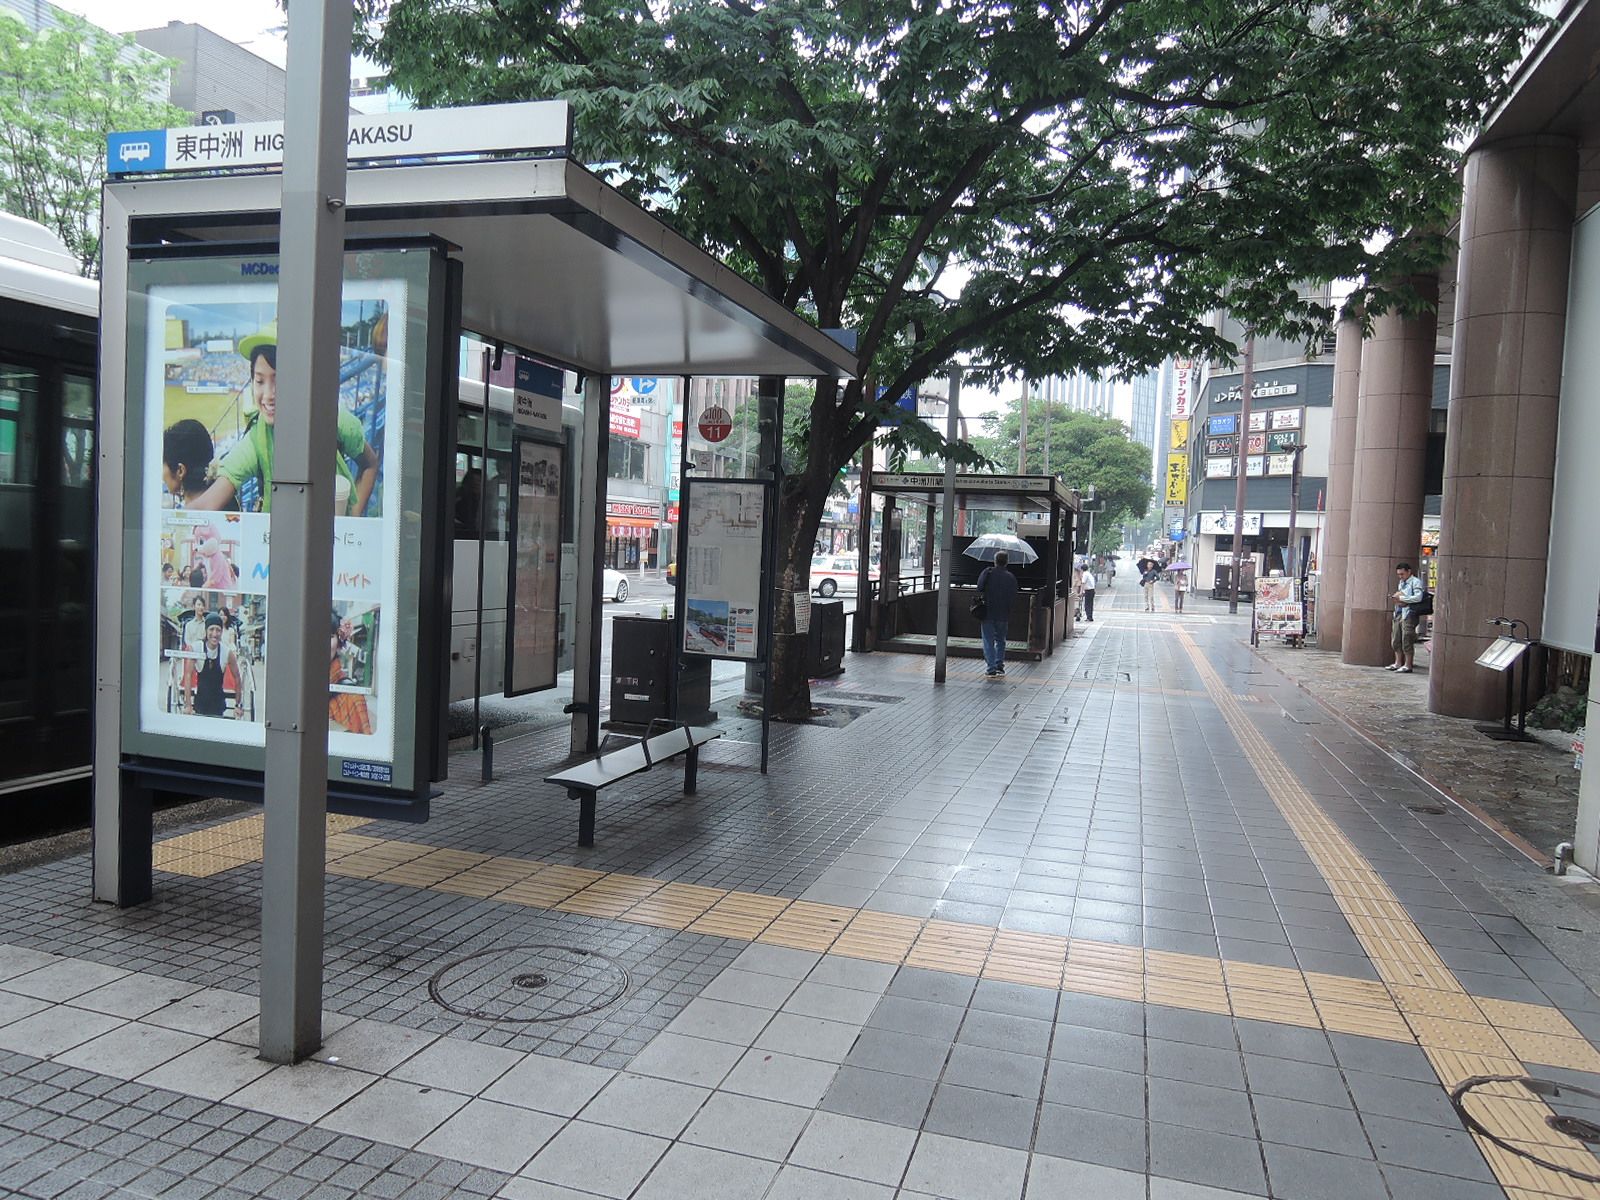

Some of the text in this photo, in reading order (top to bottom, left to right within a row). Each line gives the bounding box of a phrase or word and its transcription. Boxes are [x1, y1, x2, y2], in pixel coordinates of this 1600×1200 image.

[176, 130, 243, 161] 東中洲
[1177, 371, 1187, 414] ジャンカラ
[707, 426, 721, 439] 11
